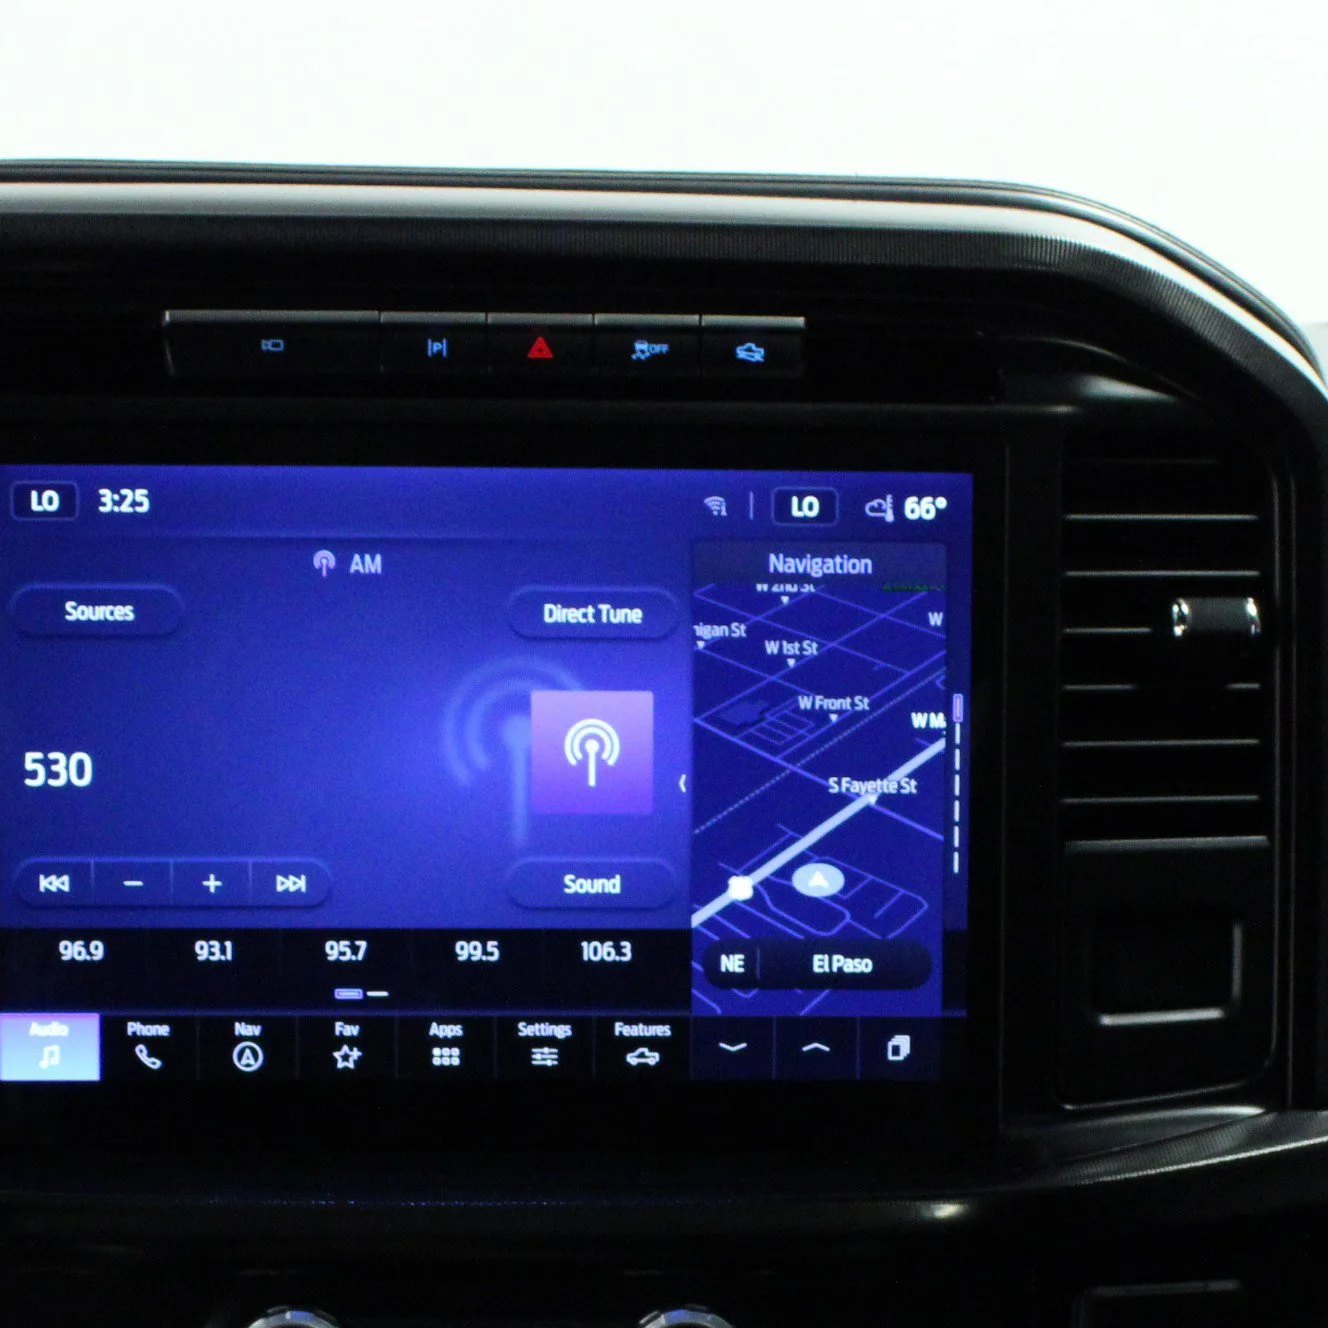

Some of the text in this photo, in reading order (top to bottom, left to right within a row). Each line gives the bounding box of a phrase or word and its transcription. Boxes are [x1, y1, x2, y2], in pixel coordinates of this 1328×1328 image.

[649, 343, 669, 355] OFF
[30, 489, 60, 512] LO
[98, 488, 150, 514] 3:25
[791, 495, 820, 518] LO
[903, 495, 948, 521] 66°
[349, 553, 382, 574] AM
[769, 553, 873, 578] Navigation
[64, 600, 136, 622] Sources
[543, 603, 643, 625] Direct Tune
[730, 620, 748, 638] St
[764, 638, 819, 656] W 1st St
[797, 694, 870, 711] W Front St
[910, 711, 928, 729] W
[24, 751, 93, 788] 530
[827, 775, 918, 798] S Fayette St
[563, 874, 621, 894] Sound
[58, 940, 104, 962] 96.9
[194, 939, 233, 962] 93.1
[324, 940, 368, 962] 95.7
[454, 940, 500, 962] 99.5
[580, 940, 632, 962] 106.3
[720, 953, 745, 973] NE
[812, 953, 873, 974] El Paso
[126, 1021, 171, 1037] Phone
[234, 1020, 263, 1037] Nav
[334, 1021, 360, 1037] Fav
[428, 1021, 464, 1039] Apps
[517, 1021, 573, 1040] Settings
[614, 1021, 672, 1037] Features
